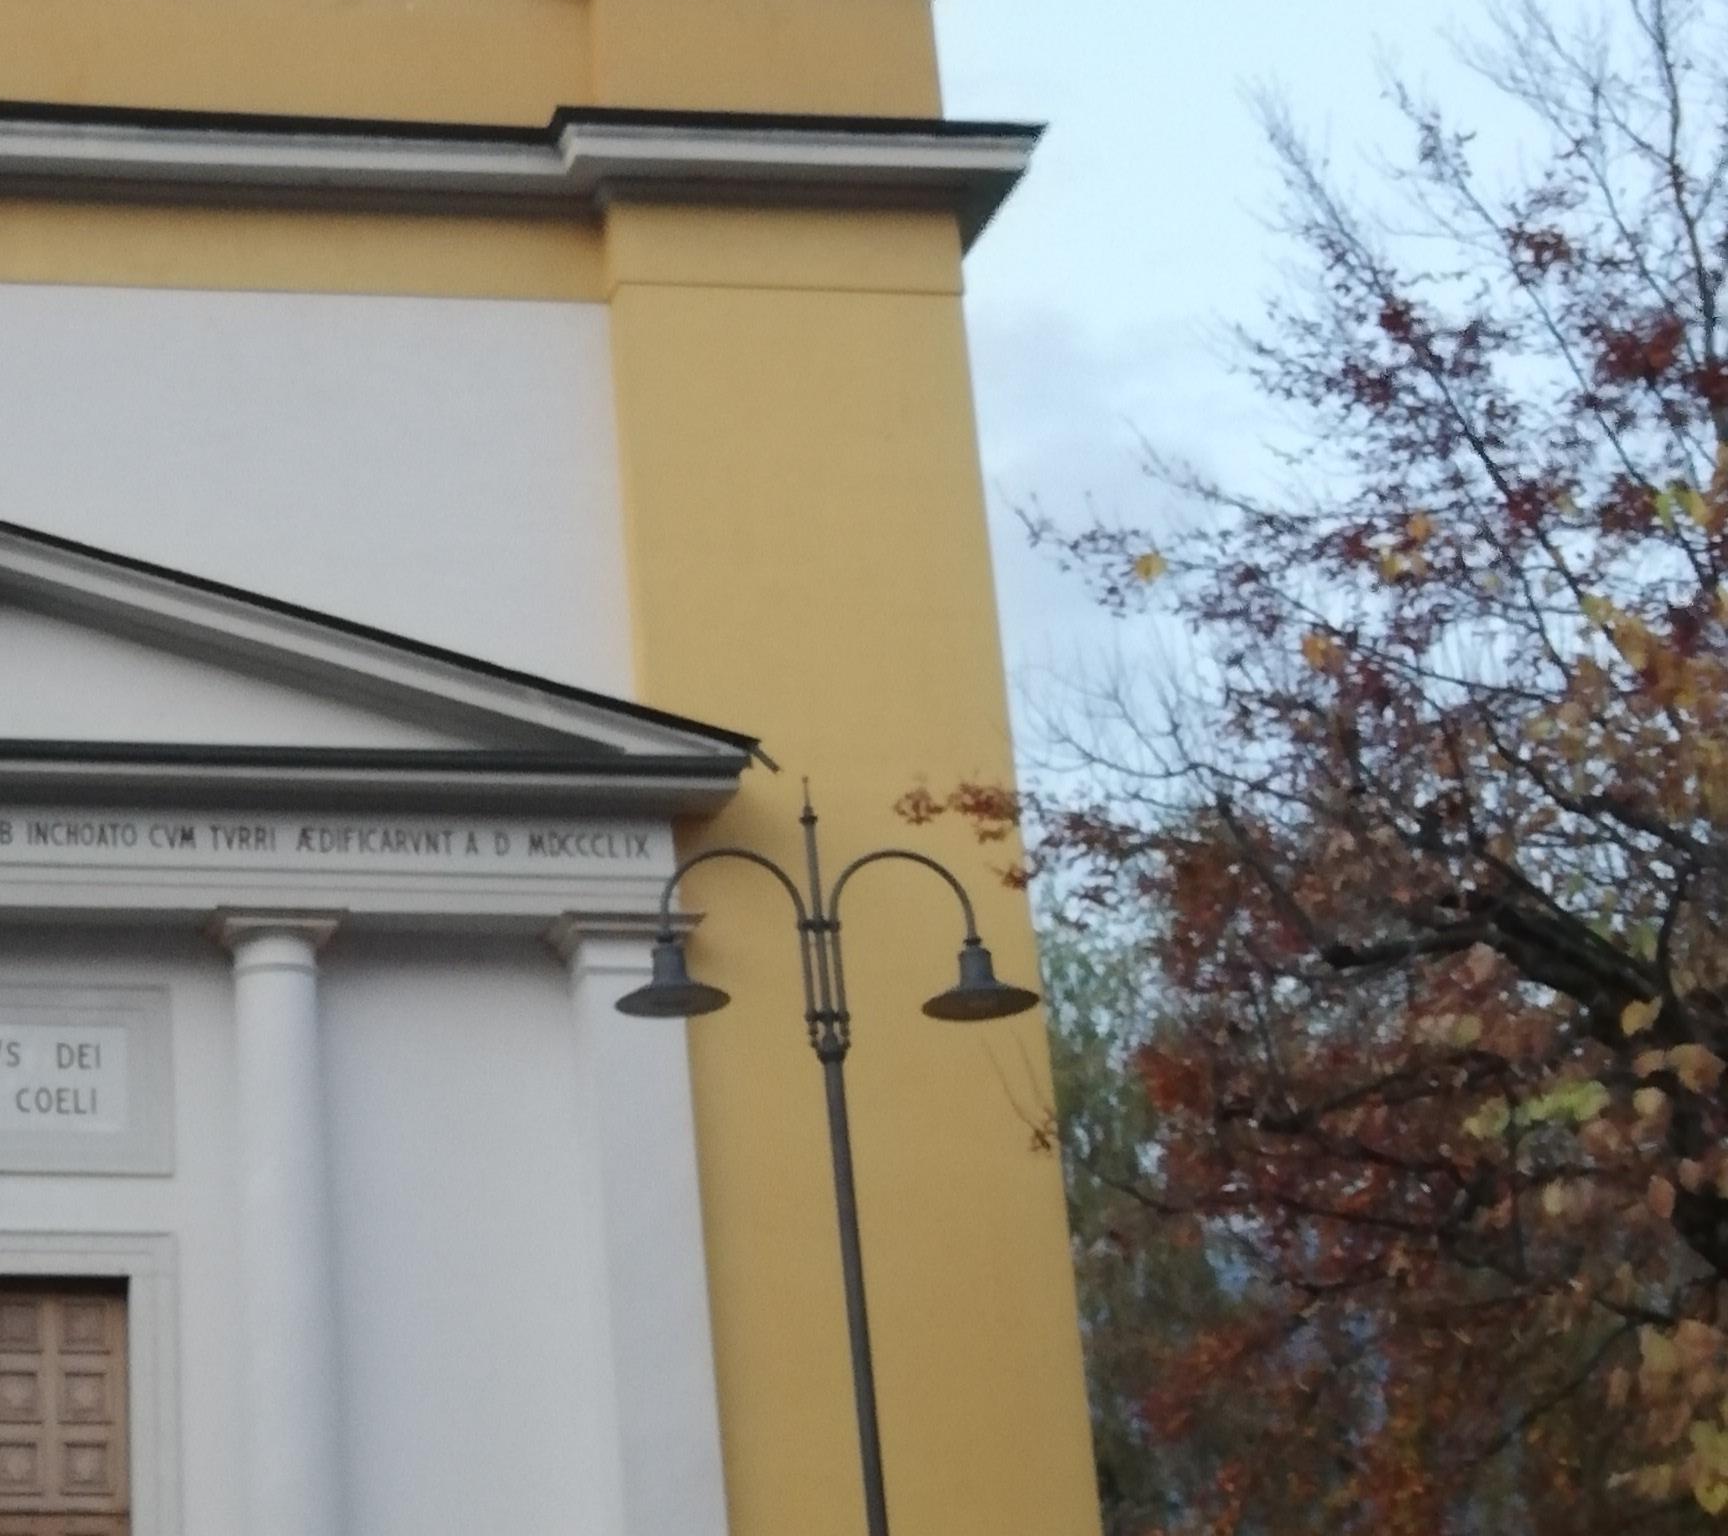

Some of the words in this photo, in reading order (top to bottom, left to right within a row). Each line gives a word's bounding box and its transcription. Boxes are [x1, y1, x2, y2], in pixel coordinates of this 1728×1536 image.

[26, 821, 138, 848] INCHOATO
[148, 823, 197, 850] CVM
[209, 825, 276, 852] TVRRI
[465, 830, 479, 856] A
[493, 832, 511, 857] D
[56, 1042, 101, 1069] DEI
[15, 1088, 97, 1114] COELI
